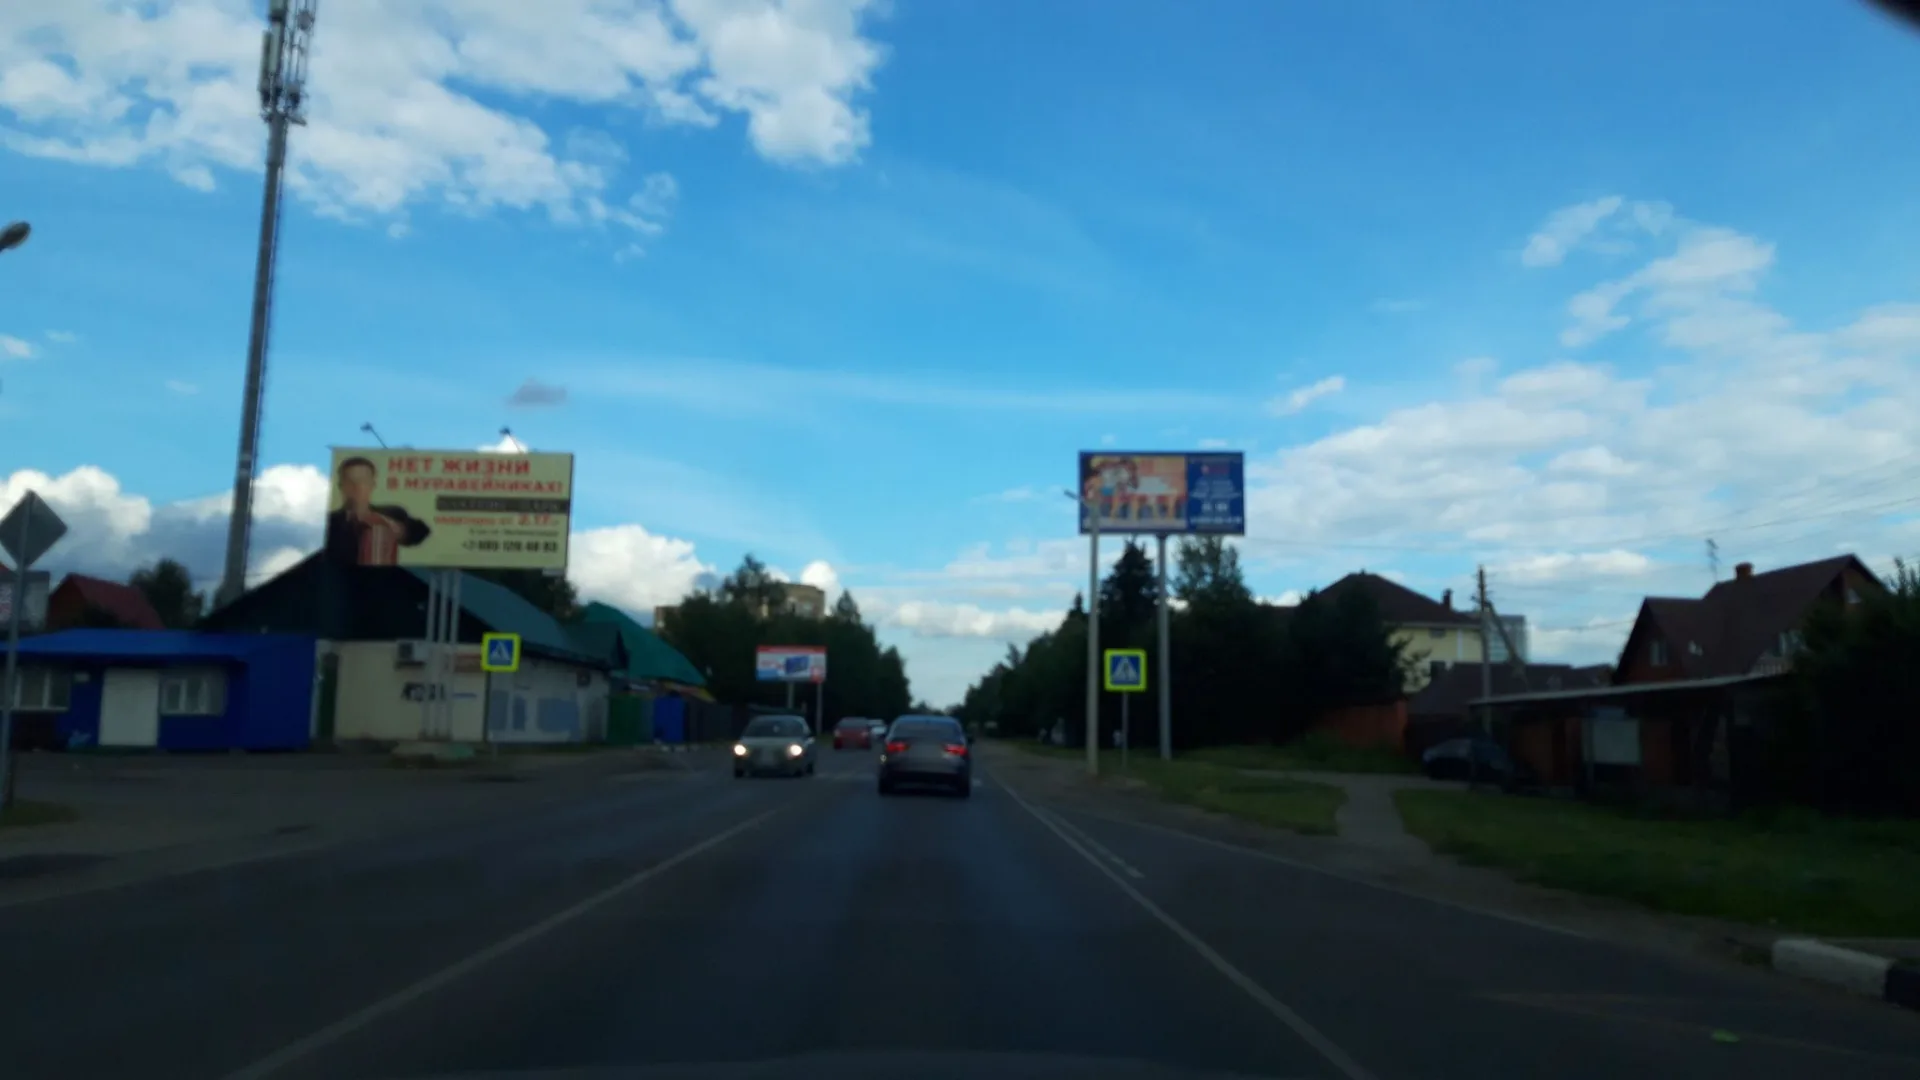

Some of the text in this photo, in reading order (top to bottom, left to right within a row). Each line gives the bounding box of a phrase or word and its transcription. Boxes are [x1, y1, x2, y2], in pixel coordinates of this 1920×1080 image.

[388, 457, 531, 475] НЕТ ЖИЗНИ
[387, 477, 398, 491] В
